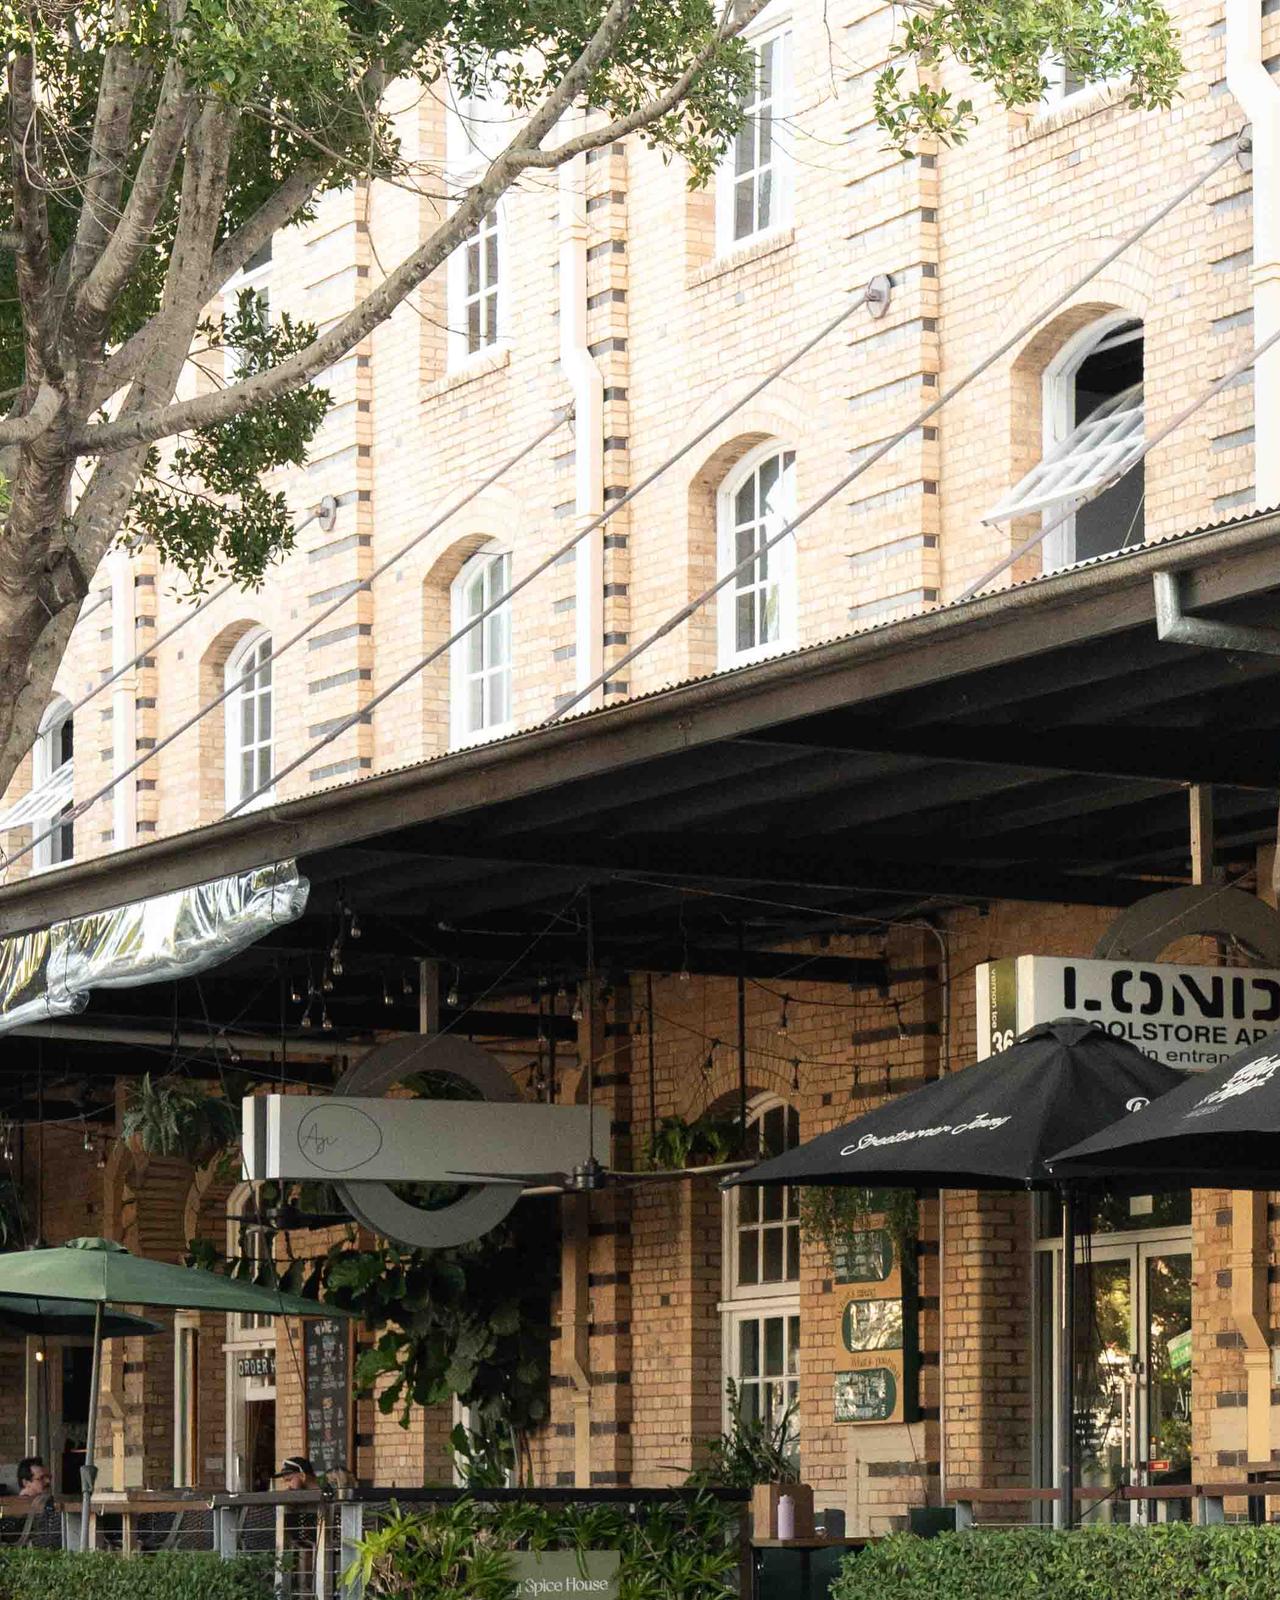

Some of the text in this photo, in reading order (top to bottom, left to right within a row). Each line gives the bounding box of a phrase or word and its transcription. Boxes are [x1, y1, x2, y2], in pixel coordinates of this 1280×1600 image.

[1165, 1051, 1231, 1065] entran
[238, 1358, 269, 1376] ORDER
[524, 1577, 563, 1598] Spice
[565, 1576, 609, 1592] House
